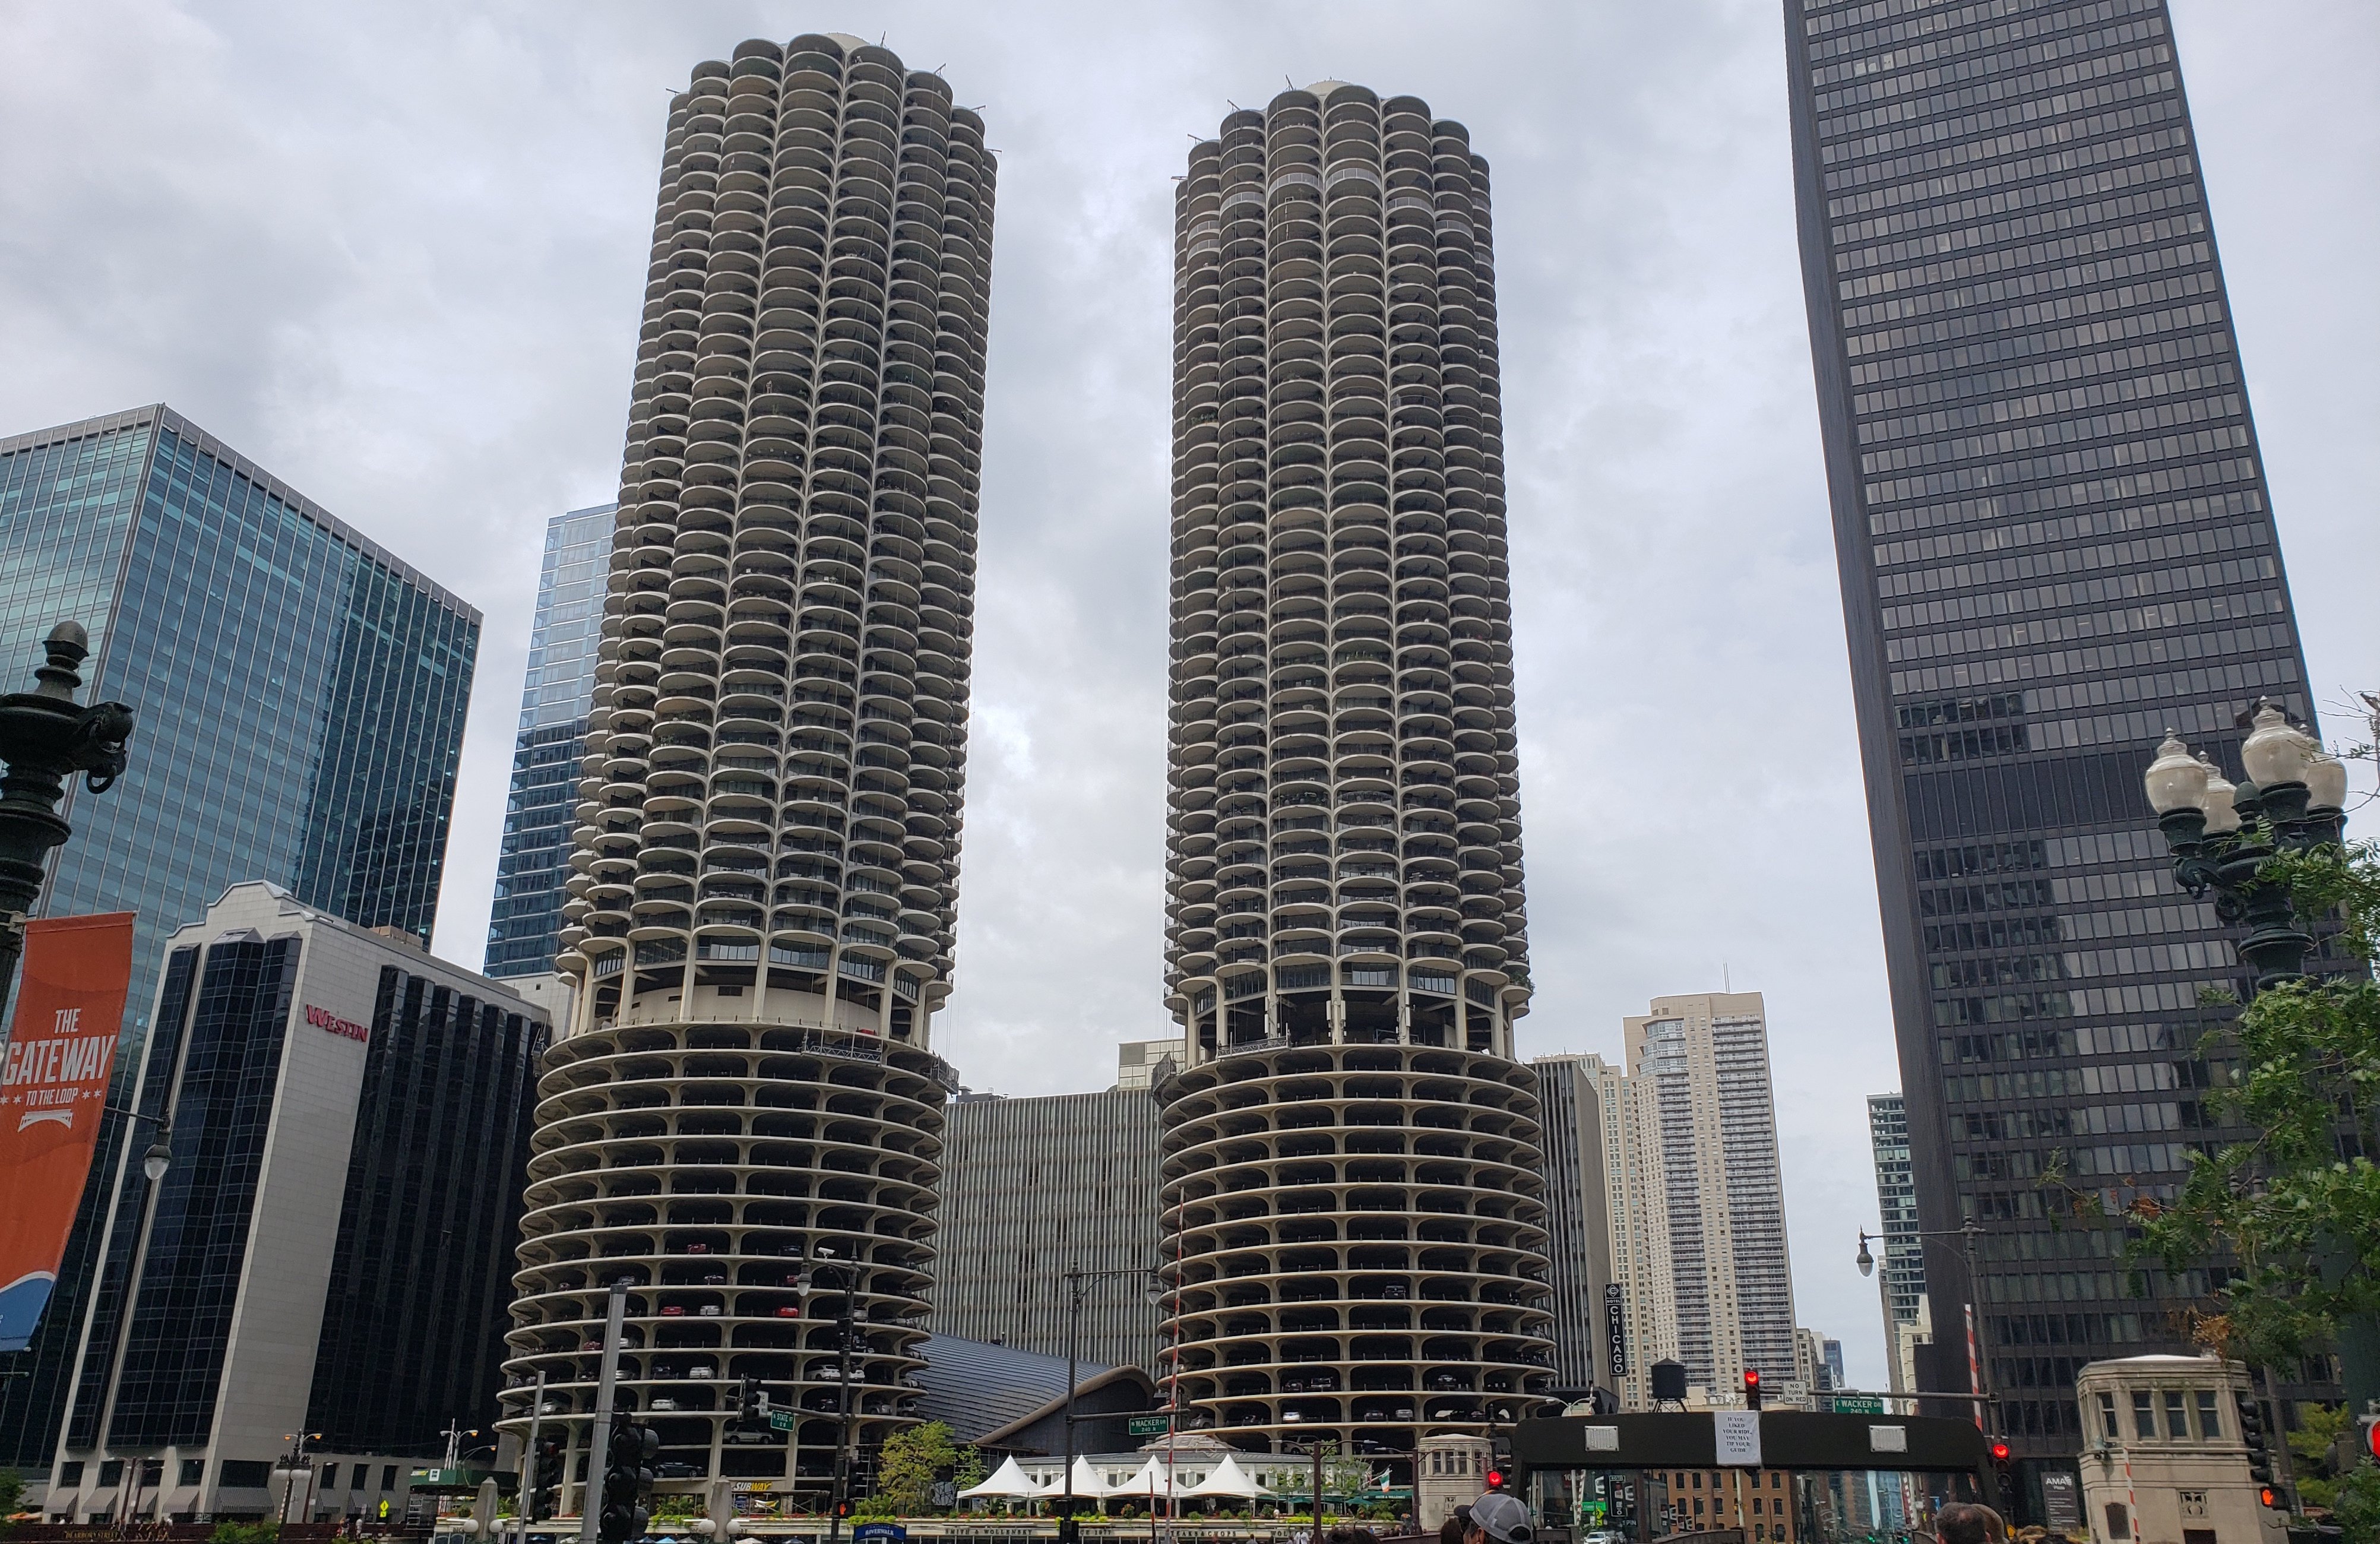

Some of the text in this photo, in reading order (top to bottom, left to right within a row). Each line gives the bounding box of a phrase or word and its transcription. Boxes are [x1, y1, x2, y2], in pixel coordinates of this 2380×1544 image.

[55, 1008, 81, 1033] THE
[306, 1004, 368, 1042] WESTIN
[2, 1035, 116, 1085] GATEWAY
[26, 1088, 78, 1106] TO THE LOOP
[1610, 1306, 1623, 1373] CHICAGO
[733, 1482, 773, 1492] SUBWAY
